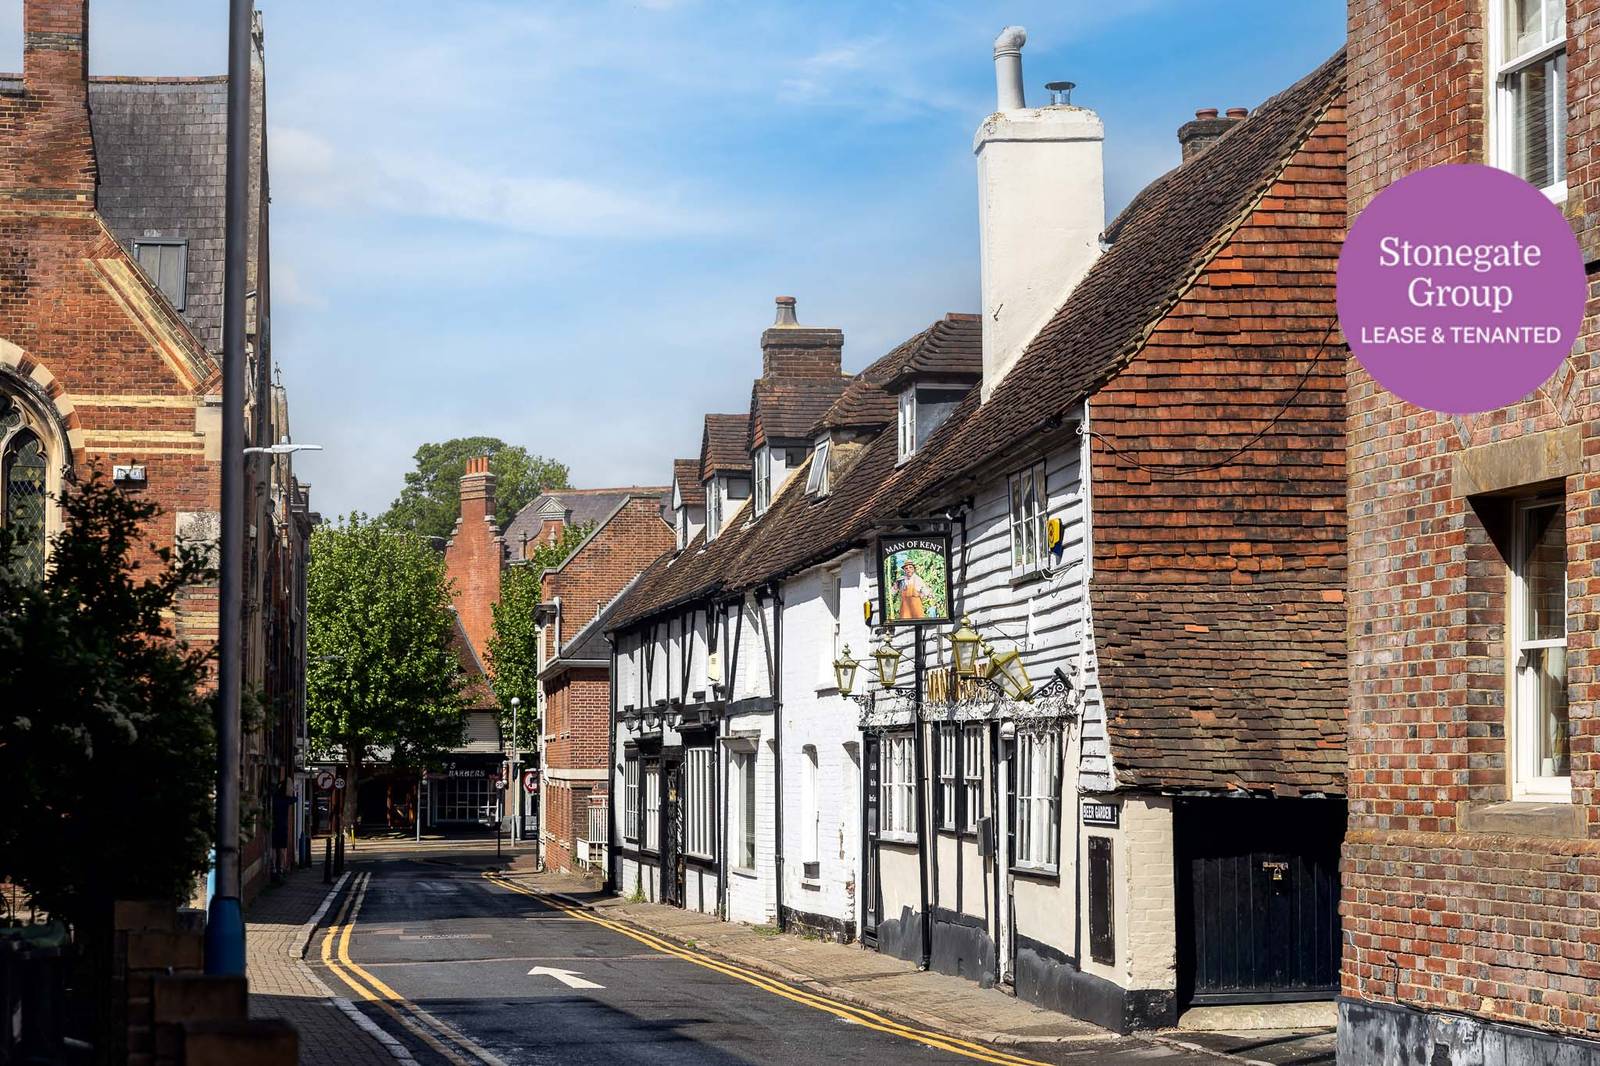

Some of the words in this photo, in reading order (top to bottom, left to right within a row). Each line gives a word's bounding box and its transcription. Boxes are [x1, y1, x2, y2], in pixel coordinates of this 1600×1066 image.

[885, 542, 905, 554] MAN
[906, 540, 918, 548] OF
[920, 540, 943, 552] KENT
[1083, 805, 1095, 819] BEER
[1095, 805, 1112, 820] GARDEN
